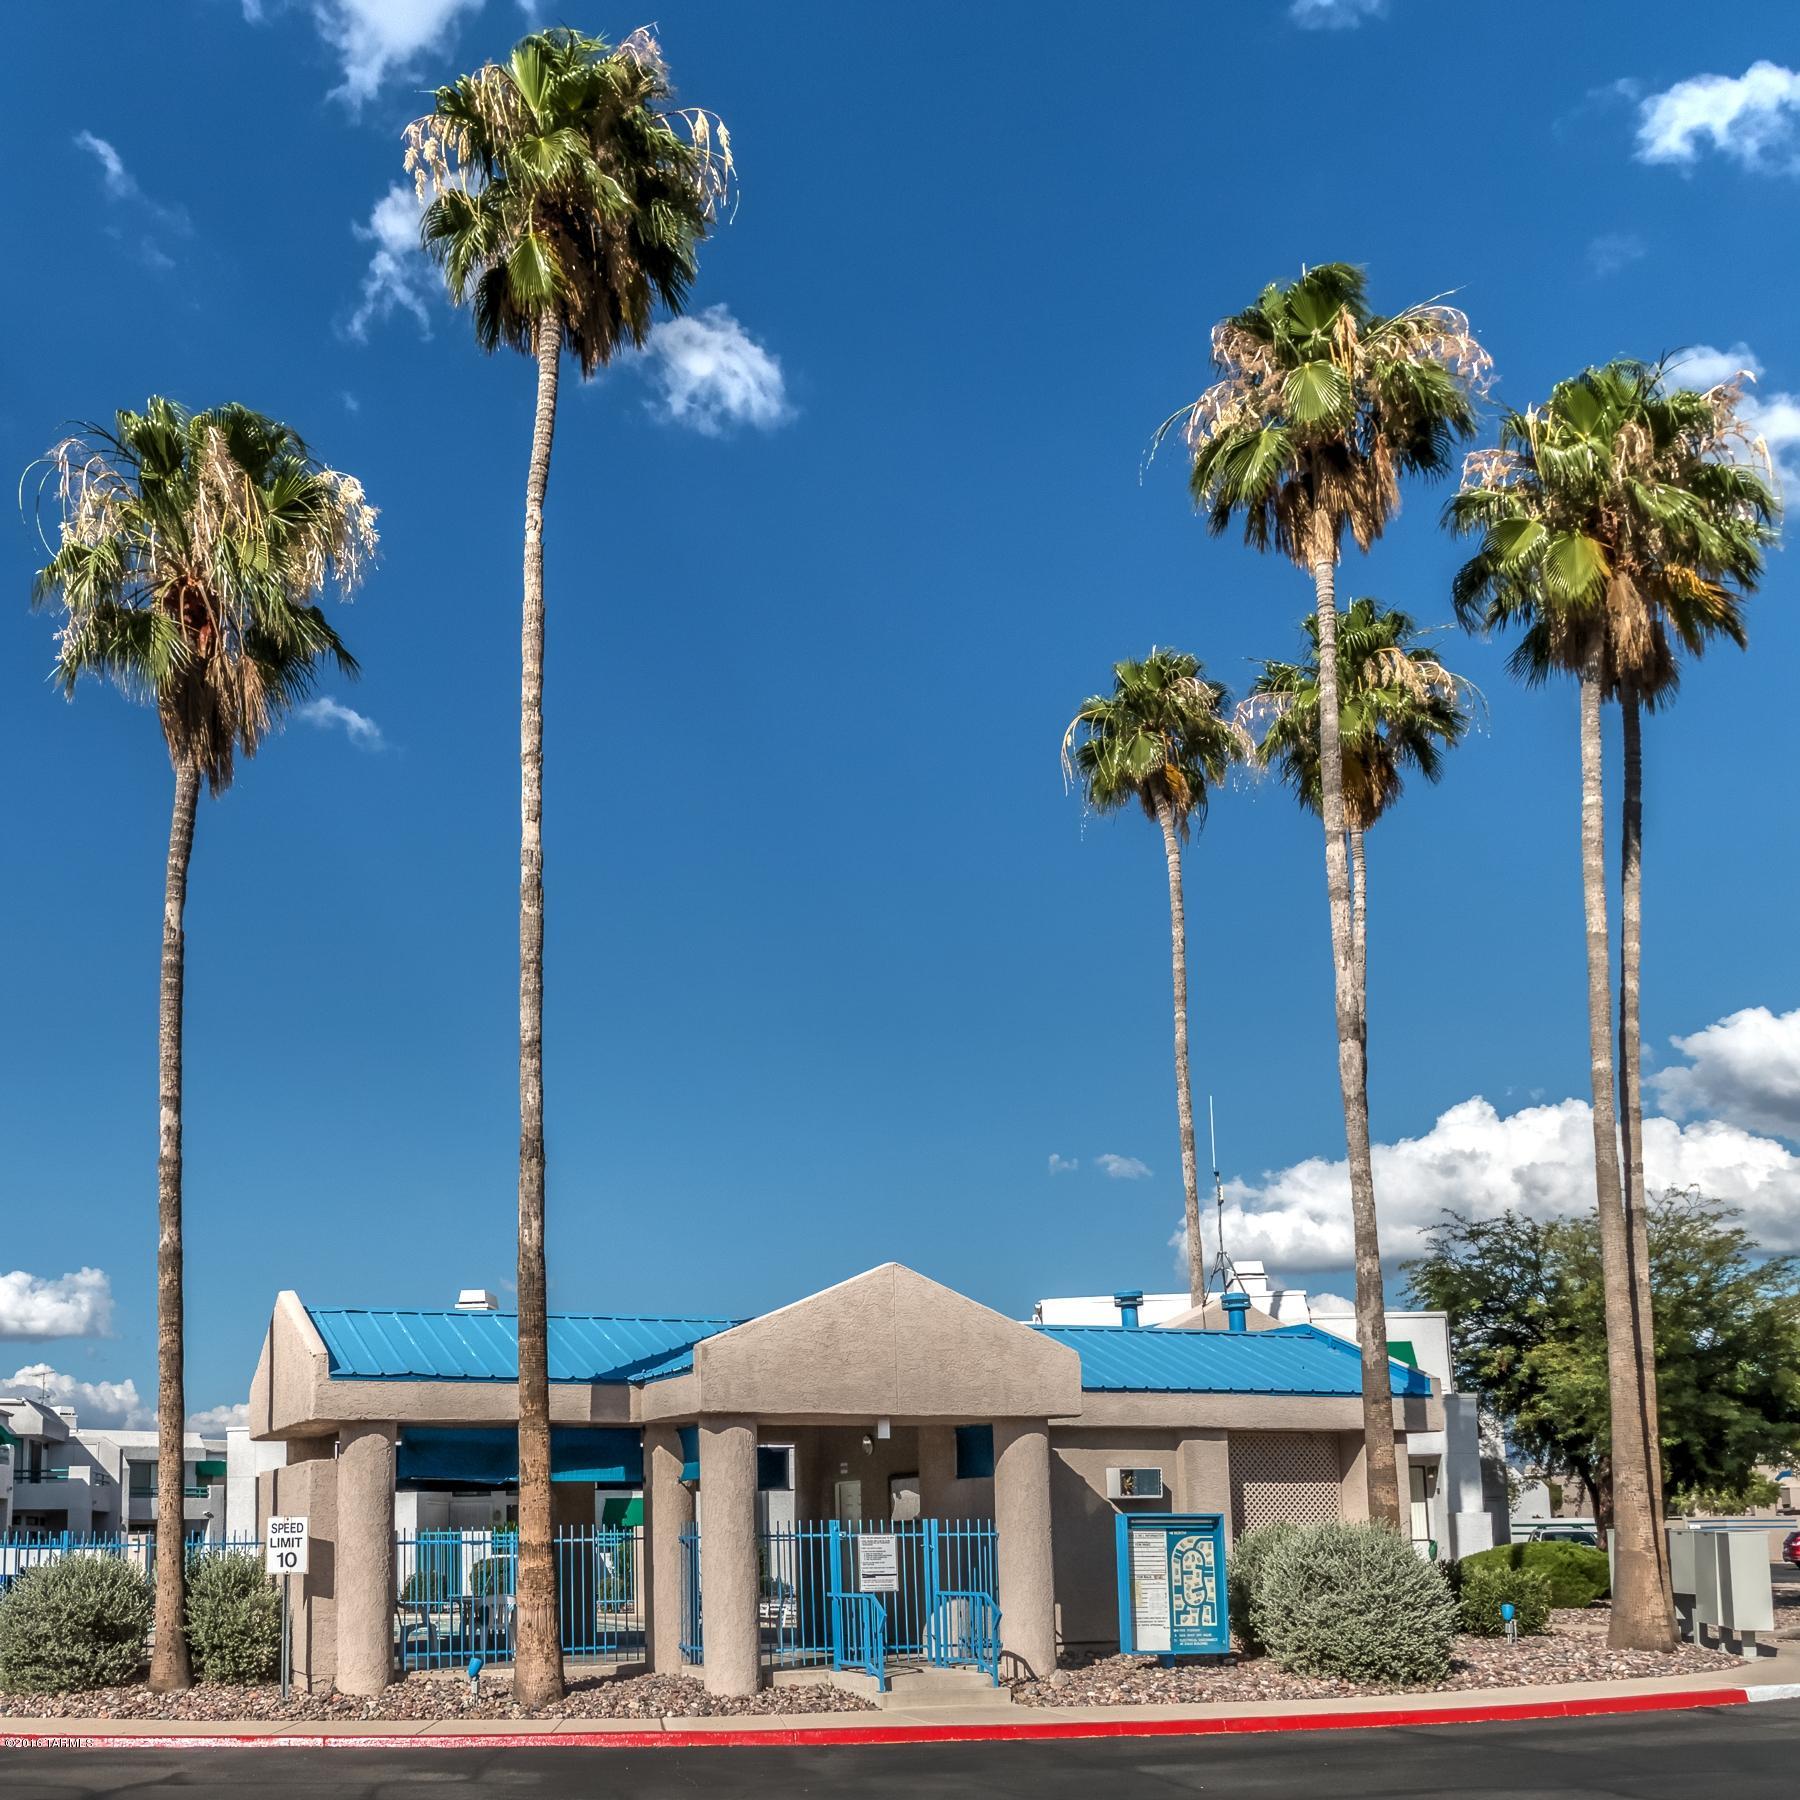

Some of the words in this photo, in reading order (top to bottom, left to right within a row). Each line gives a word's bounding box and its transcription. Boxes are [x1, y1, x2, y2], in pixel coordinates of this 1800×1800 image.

[271, 1522, 304, 1534] SPEED
[270, 1537, 303, 1548] LIMIT
[276, 1551, 297, 1568] 10
